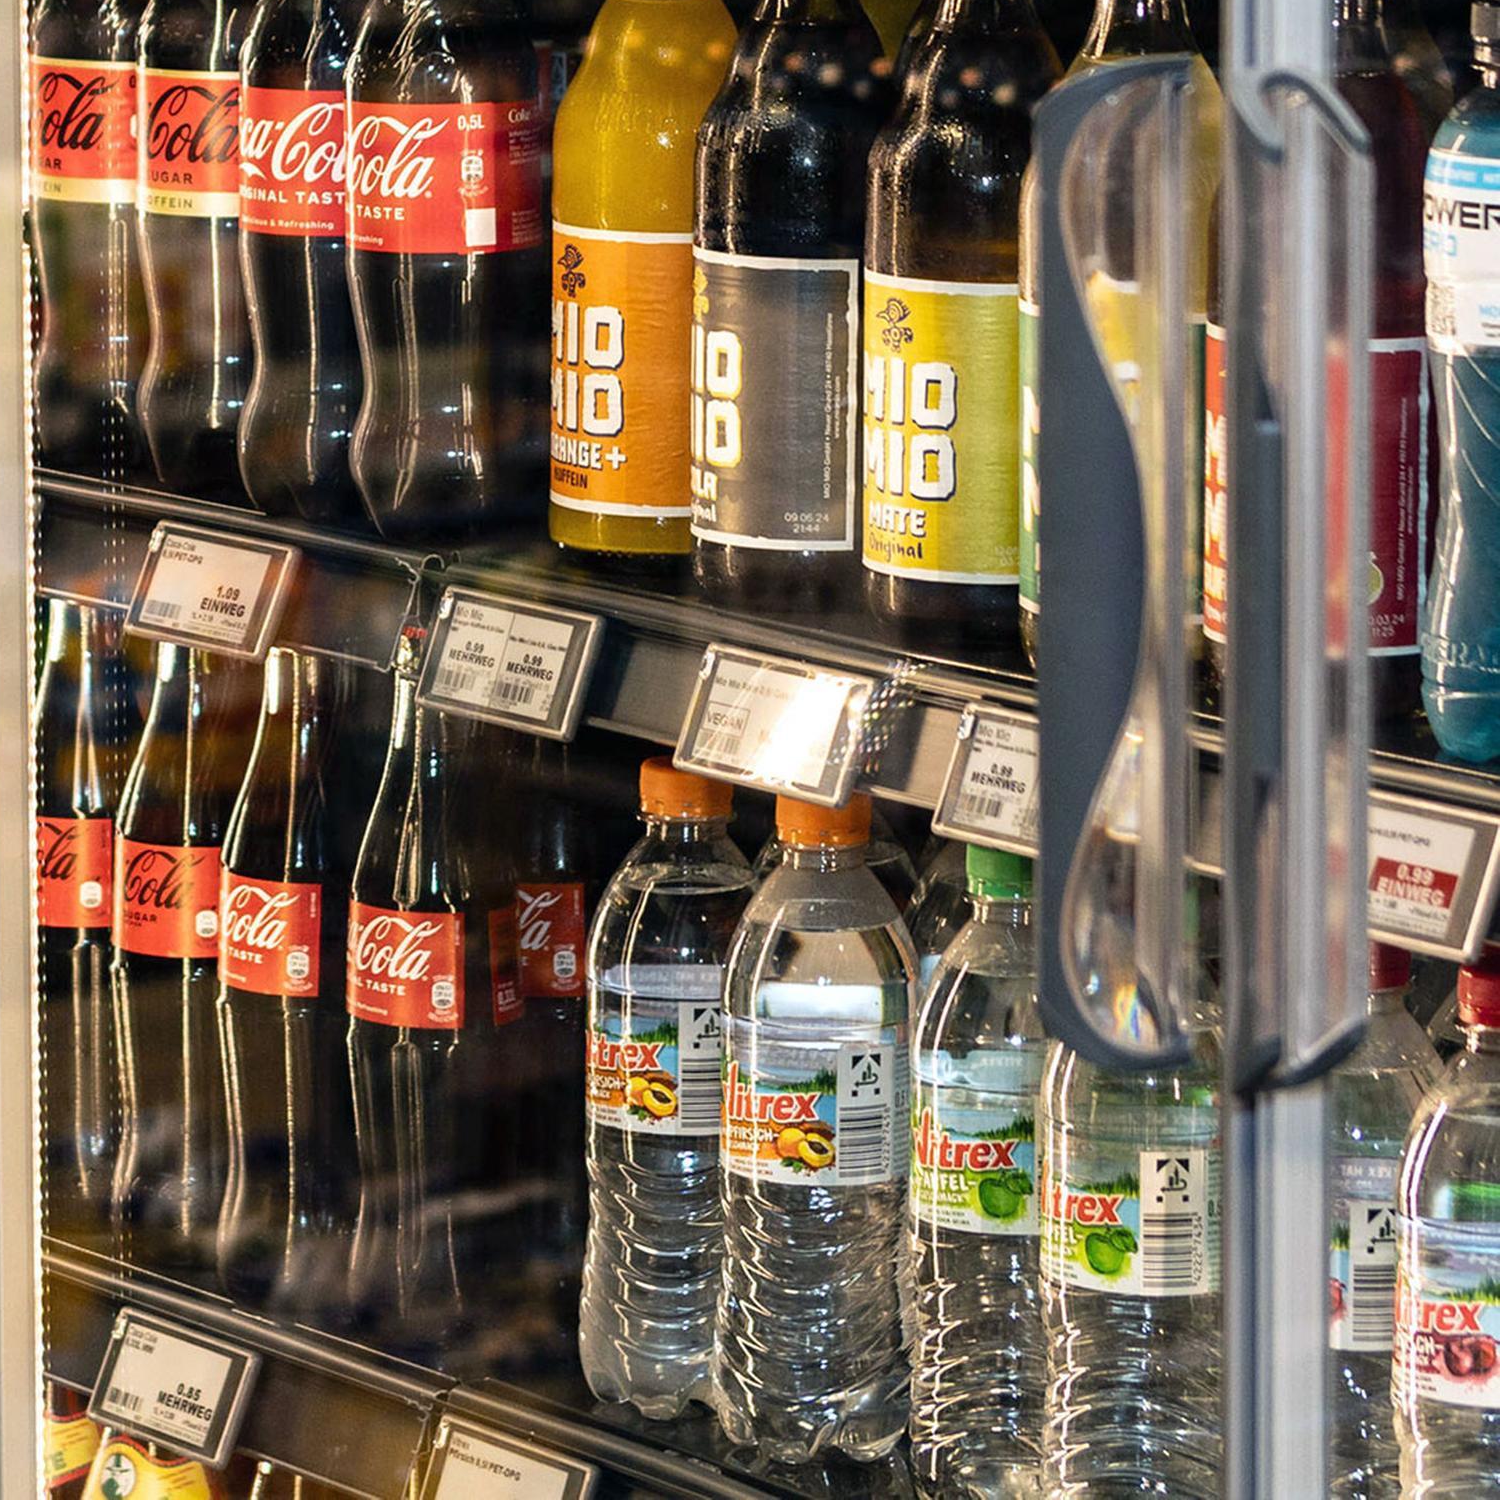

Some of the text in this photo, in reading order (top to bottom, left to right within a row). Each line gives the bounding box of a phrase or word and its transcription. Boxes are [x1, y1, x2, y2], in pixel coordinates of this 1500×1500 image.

[457, 114, 485, 133] 0,5L
[357, 203, 405, 221] TASTE
[278, 218, 334, 231] Refreshing
[691, 322, 742, 400] IO
[864, 351, 958, 430] MIO
[691, 391, 742, 468] IO
[864, 423, 958, 502] MIO
[869, 501, 927, 538] MATE
[217, 585, 240, 601] 1.09
[200, 597, 246, 618] EINWEG
[449, 648, 495, 668] MEHRWEG
[506, 661, 554, 682] MEHRWEG
[707, 711, 744, 731] VEGAN
[971, 771, 1026, 795] MEHRWEG
[1396, 863, 1435, 886] 0.99
[1377, 876, 1445, 908] EINWEG
[229, 947, 263, 964] TASTE
[366, 978, 407, 996] TASTE
[177, 1382, 202, 1402] 0.85
[157, 1391, 213, 1422] MEHRWEG
